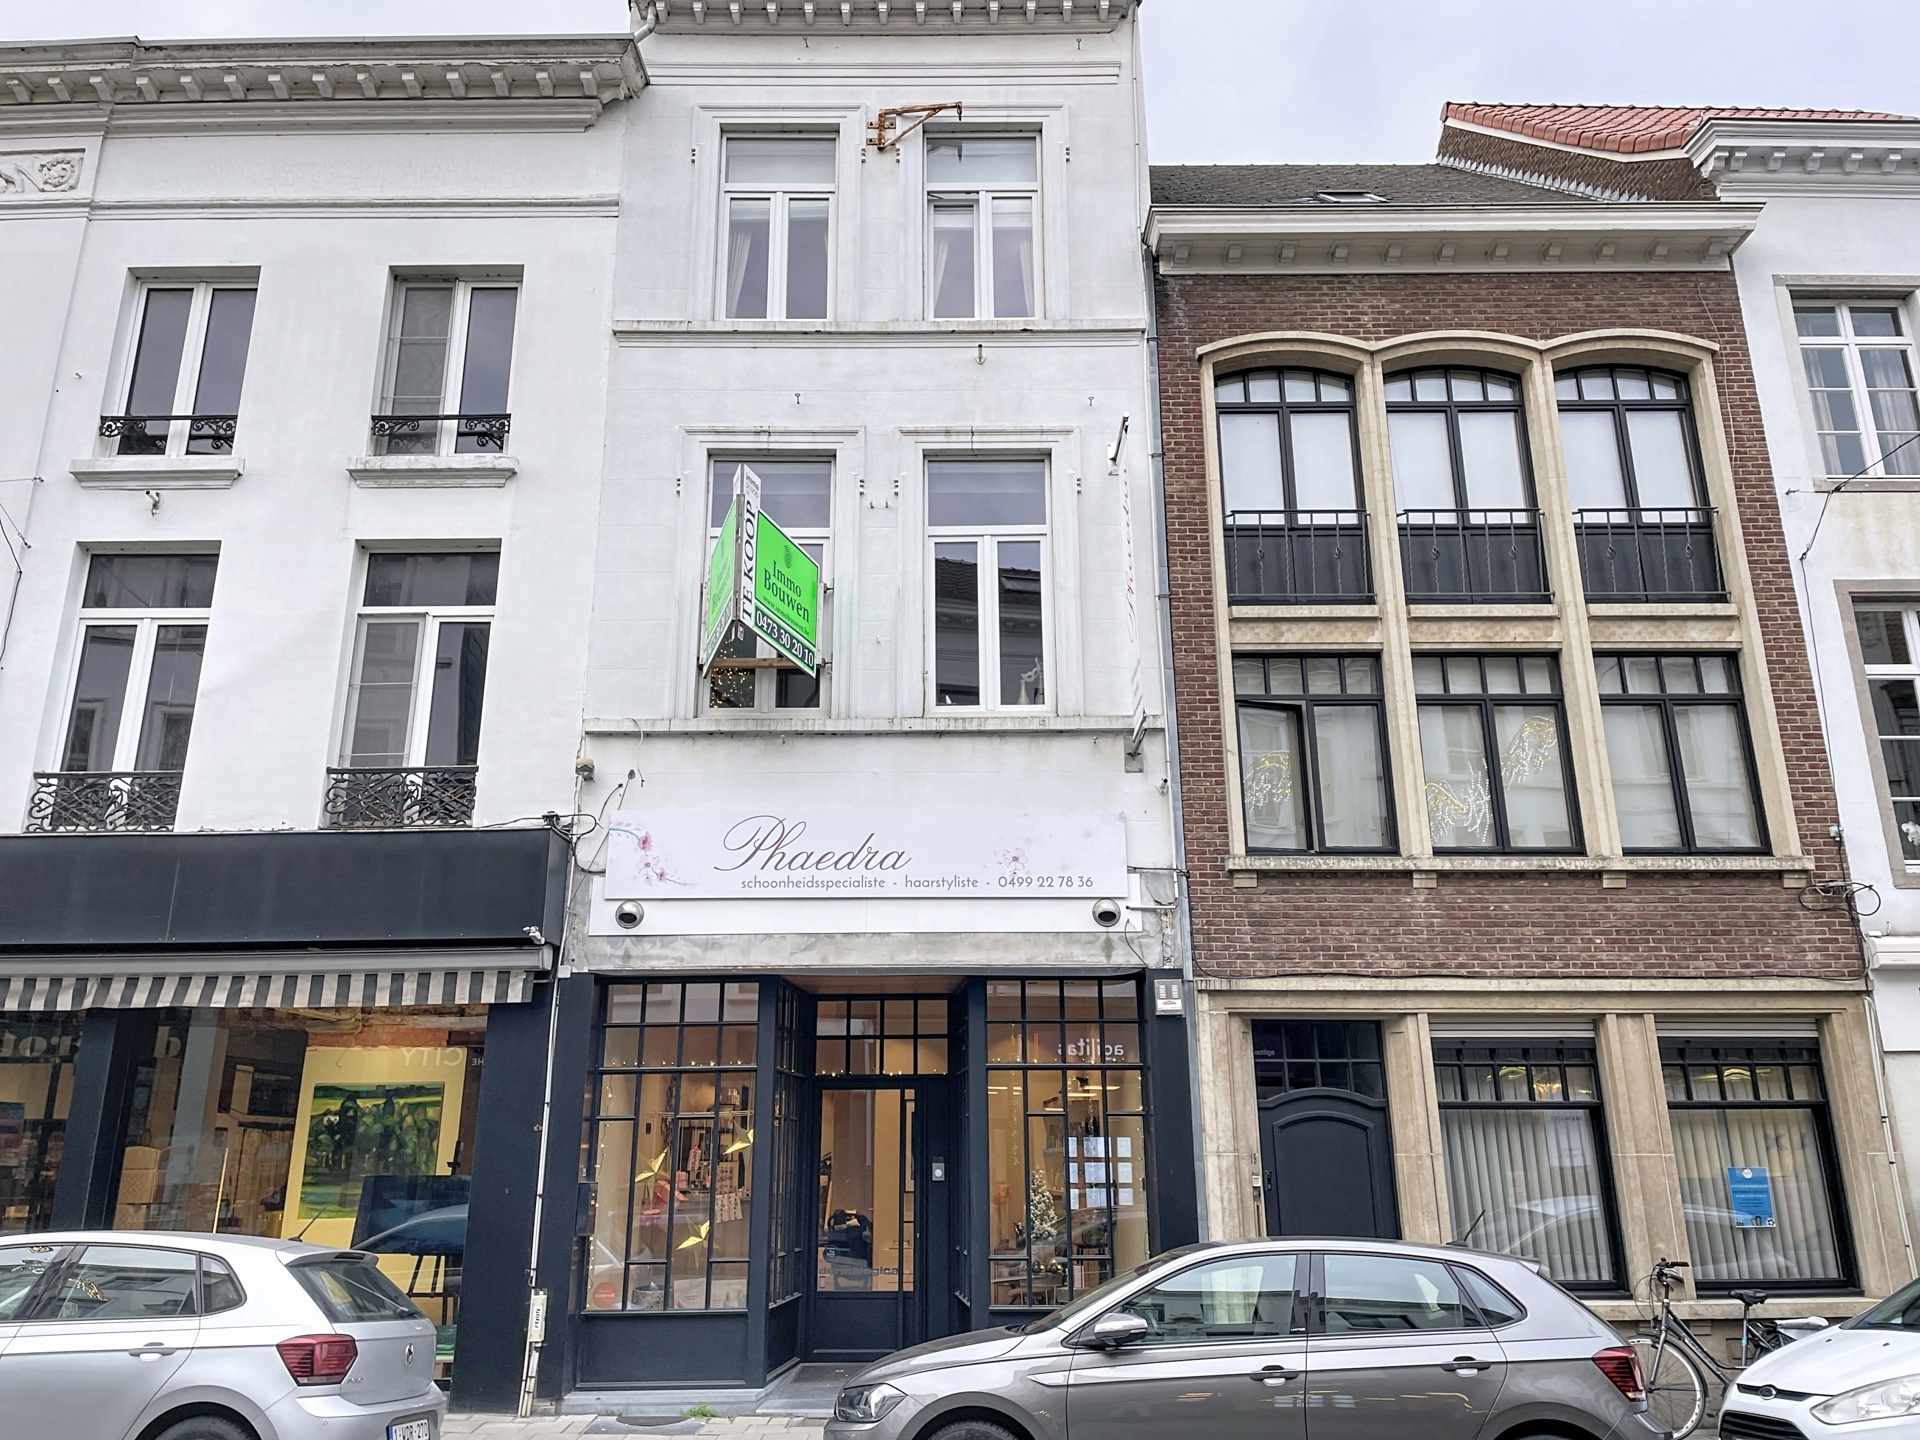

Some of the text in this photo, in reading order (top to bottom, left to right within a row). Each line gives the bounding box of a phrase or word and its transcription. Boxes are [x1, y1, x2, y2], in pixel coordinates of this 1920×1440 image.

[743, 500, 756, 582] KOOP
[764, 568, 809, 623] Bouwen
[773, 560, 801, 597] Immo
[742, 587, 753, 619] TE
[756, 610, 814, 667] 0473 30 20 10
[713, 815, 912, 871] Phaedra
[741, 875, 886, 891] schoonheidsspecialiste
[905, 875, 979, 890] haarstyliste
[998, 876, 1033, 888] 0499
[1037, 876, 1055, 888] 22
[1058, 876, 1074, 888] 78
[1078, 876, 1094, 888] 36
[820, 1266, 899, 1277] dermalogica
